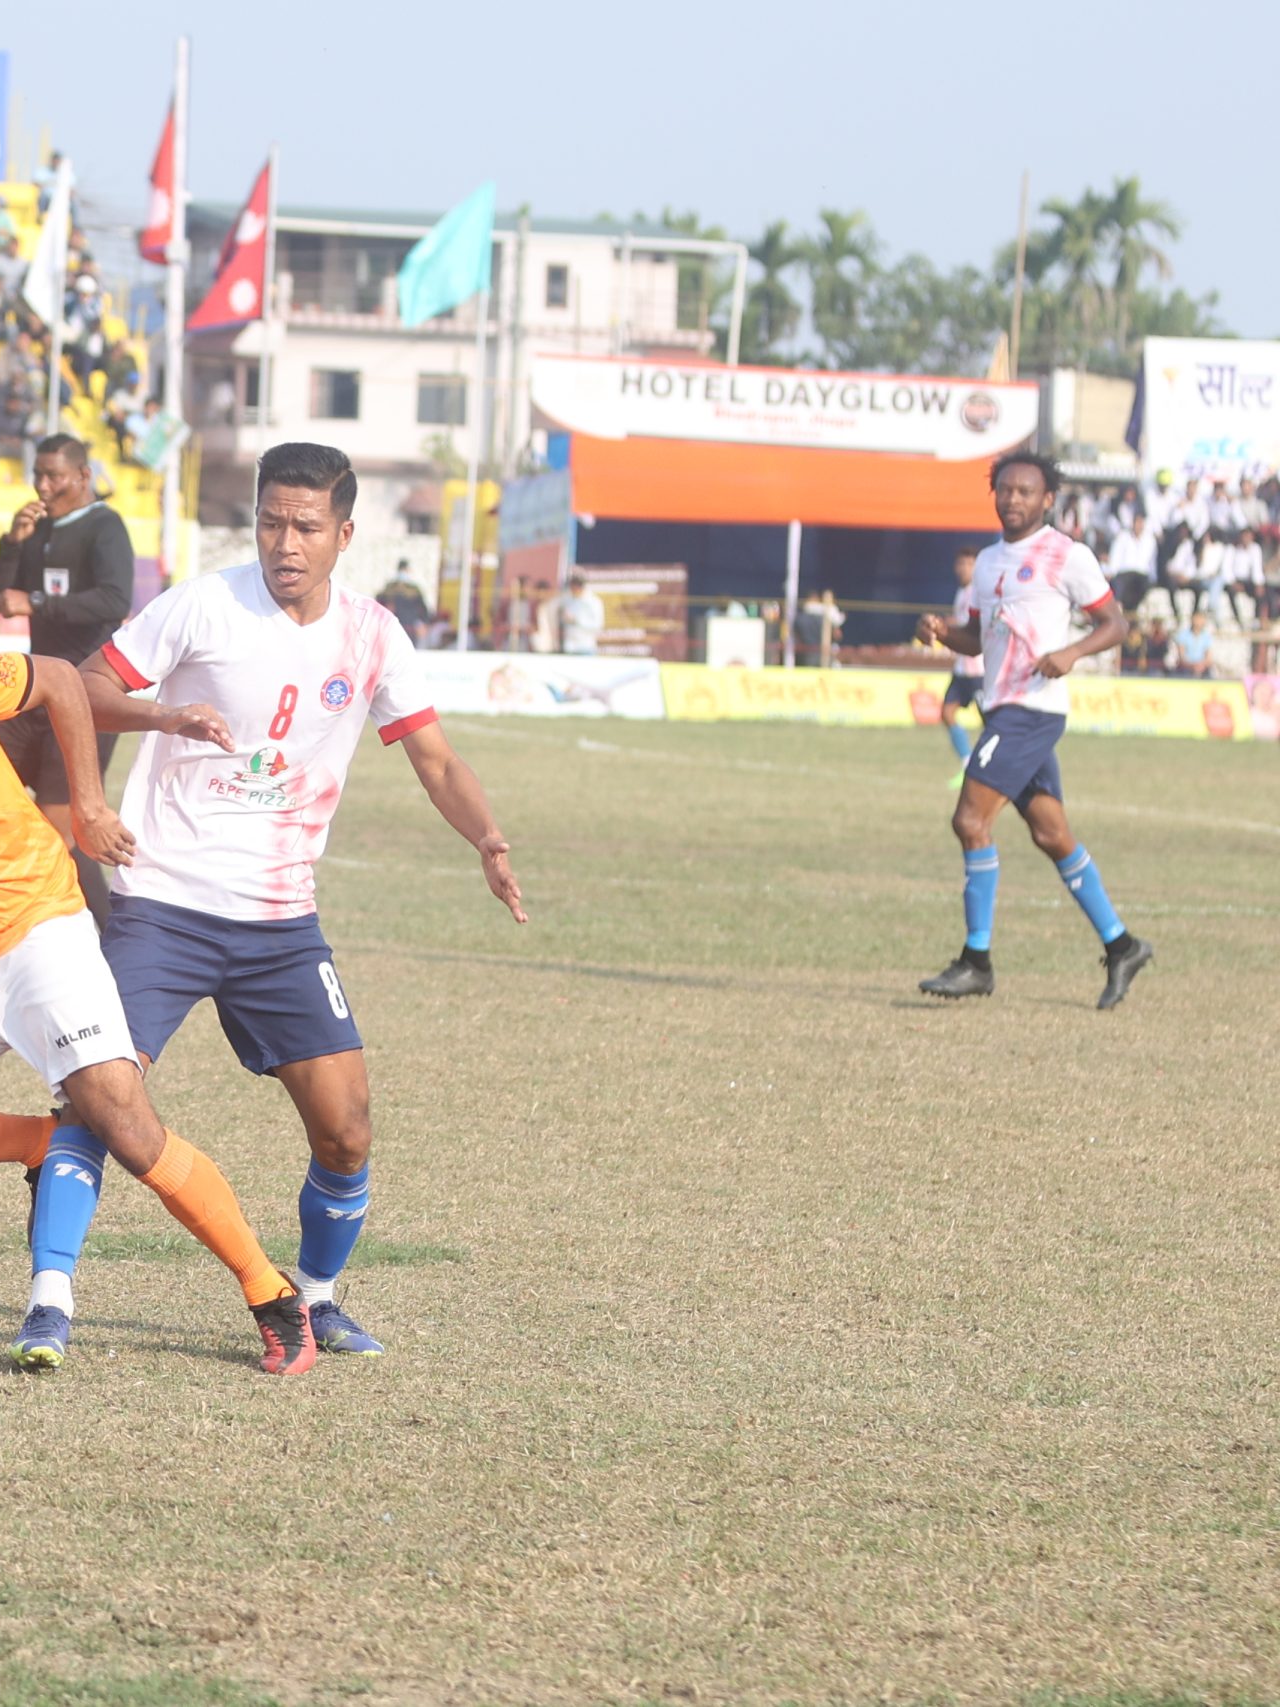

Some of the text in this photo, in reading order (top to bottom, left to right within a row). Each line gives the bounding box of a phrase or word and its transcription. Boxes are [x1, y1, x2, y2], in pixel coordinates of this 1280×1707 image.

[621, 368, 951, 415] HOTEL DAYGLOW
[268, 684, 299, 741] 8
[977, 734, 1001, 768] 4
[208, 778, 246, 799] PEPE
[248, 790, 298, 809] PIZZA
[318, 960, 349, 1020] 8
[55, 1023, 103, 1049] KELME
